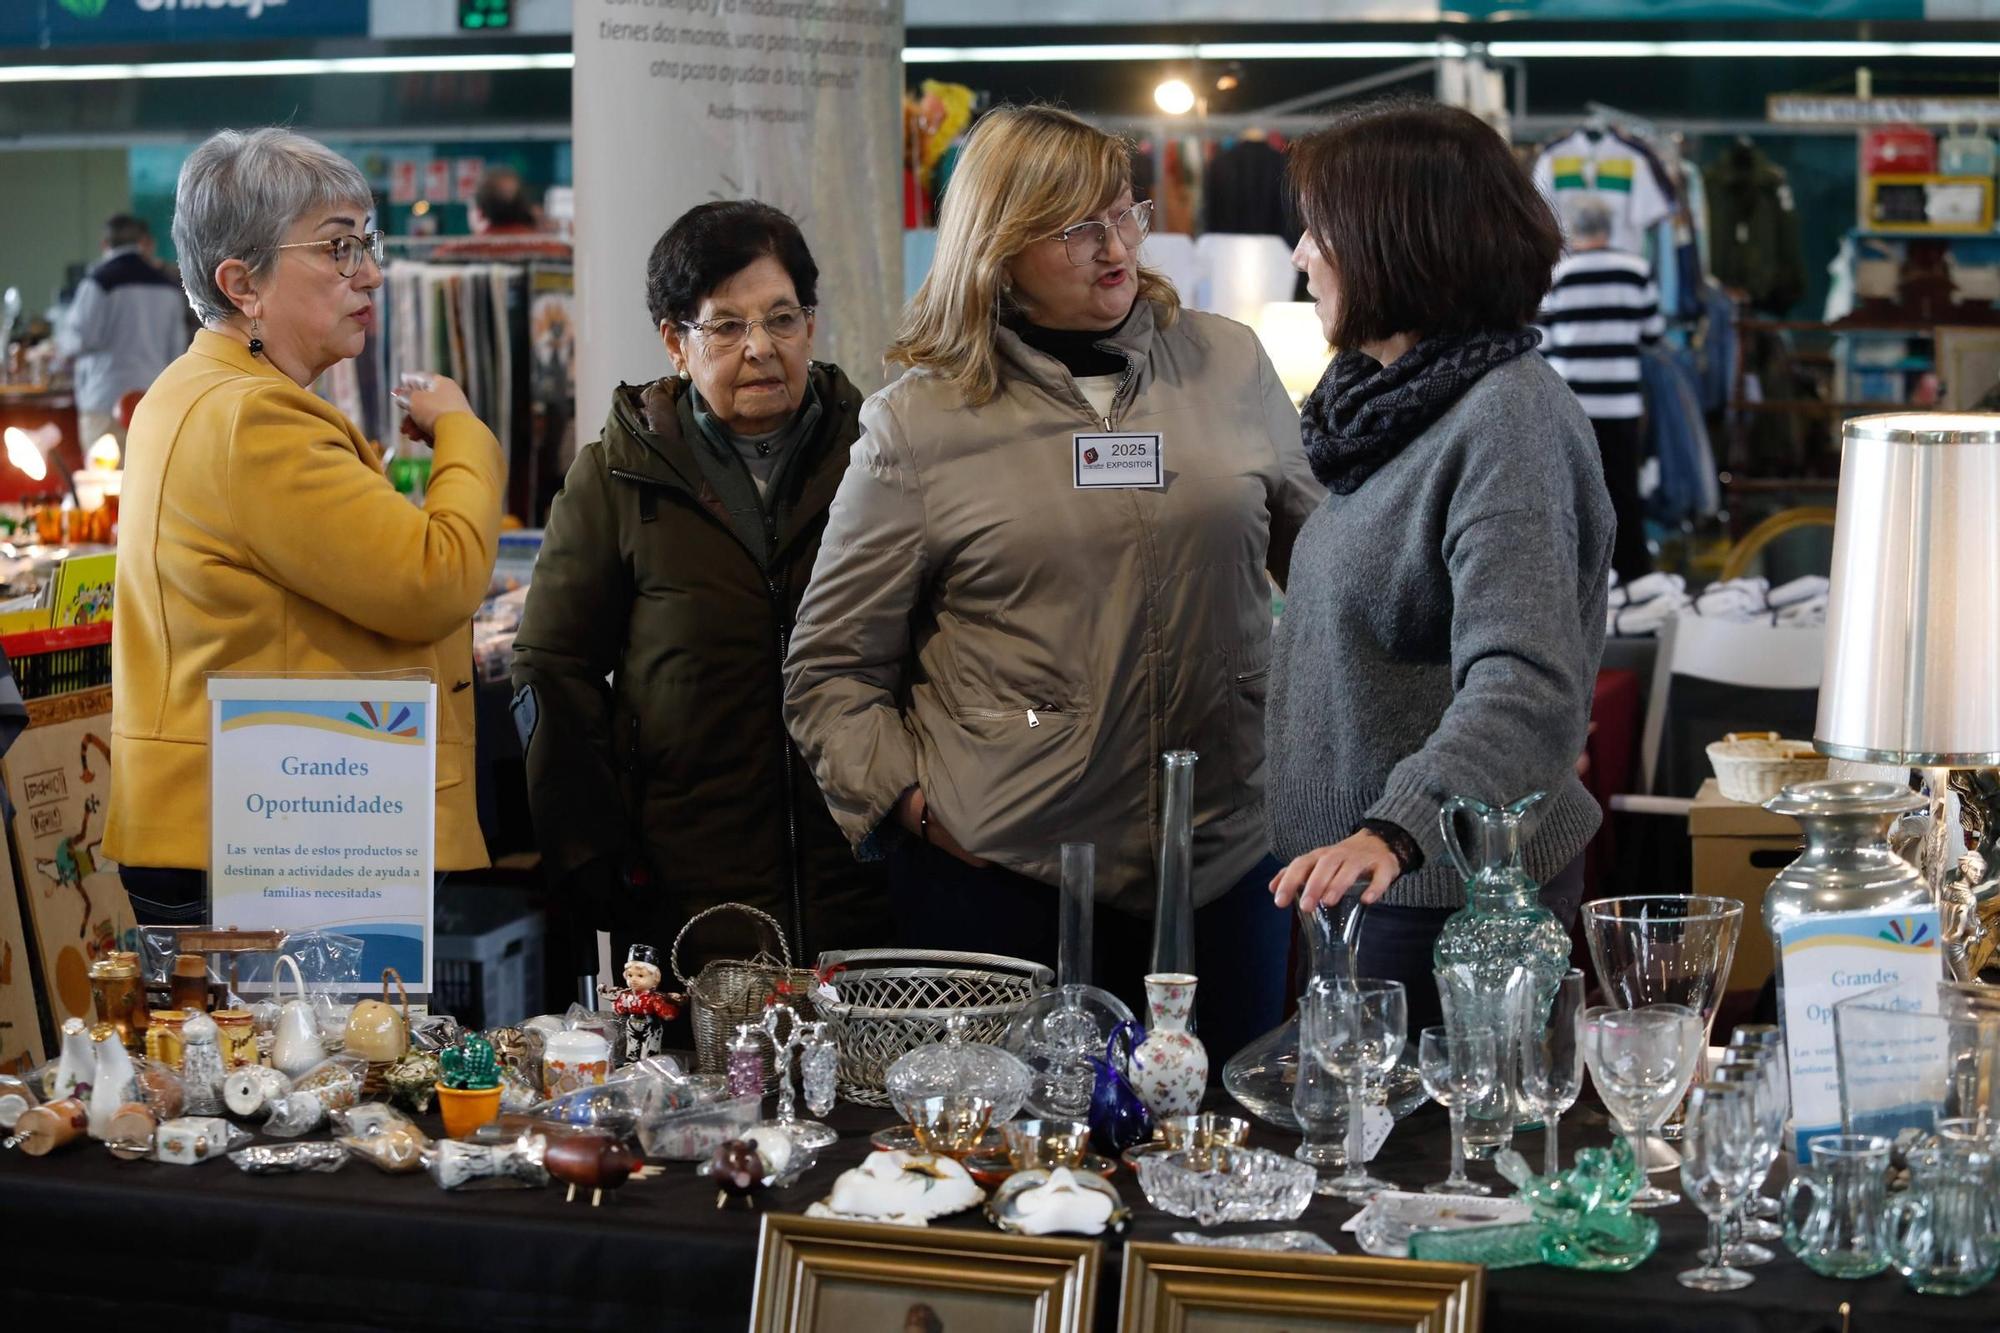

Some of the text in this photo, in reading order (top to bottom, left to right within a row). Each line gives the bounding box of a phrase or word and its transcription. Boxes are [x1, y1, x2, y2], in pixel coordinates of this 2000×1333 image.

[599, 19, 649, 42] tienes
[1111, 444, 1146, 456] 2025
[281, 756, 369, 776] Grandes
[246, 793, 404, 819] Oportunidades
[226, 843, 419, 859] Las ventas de estos productos se
[224, 864, 420, 881] destinan a actividades de ayuda a
[263, 886, 382, 900] familias necesitadas
[1831, 968, 1898, 986] Grandes
